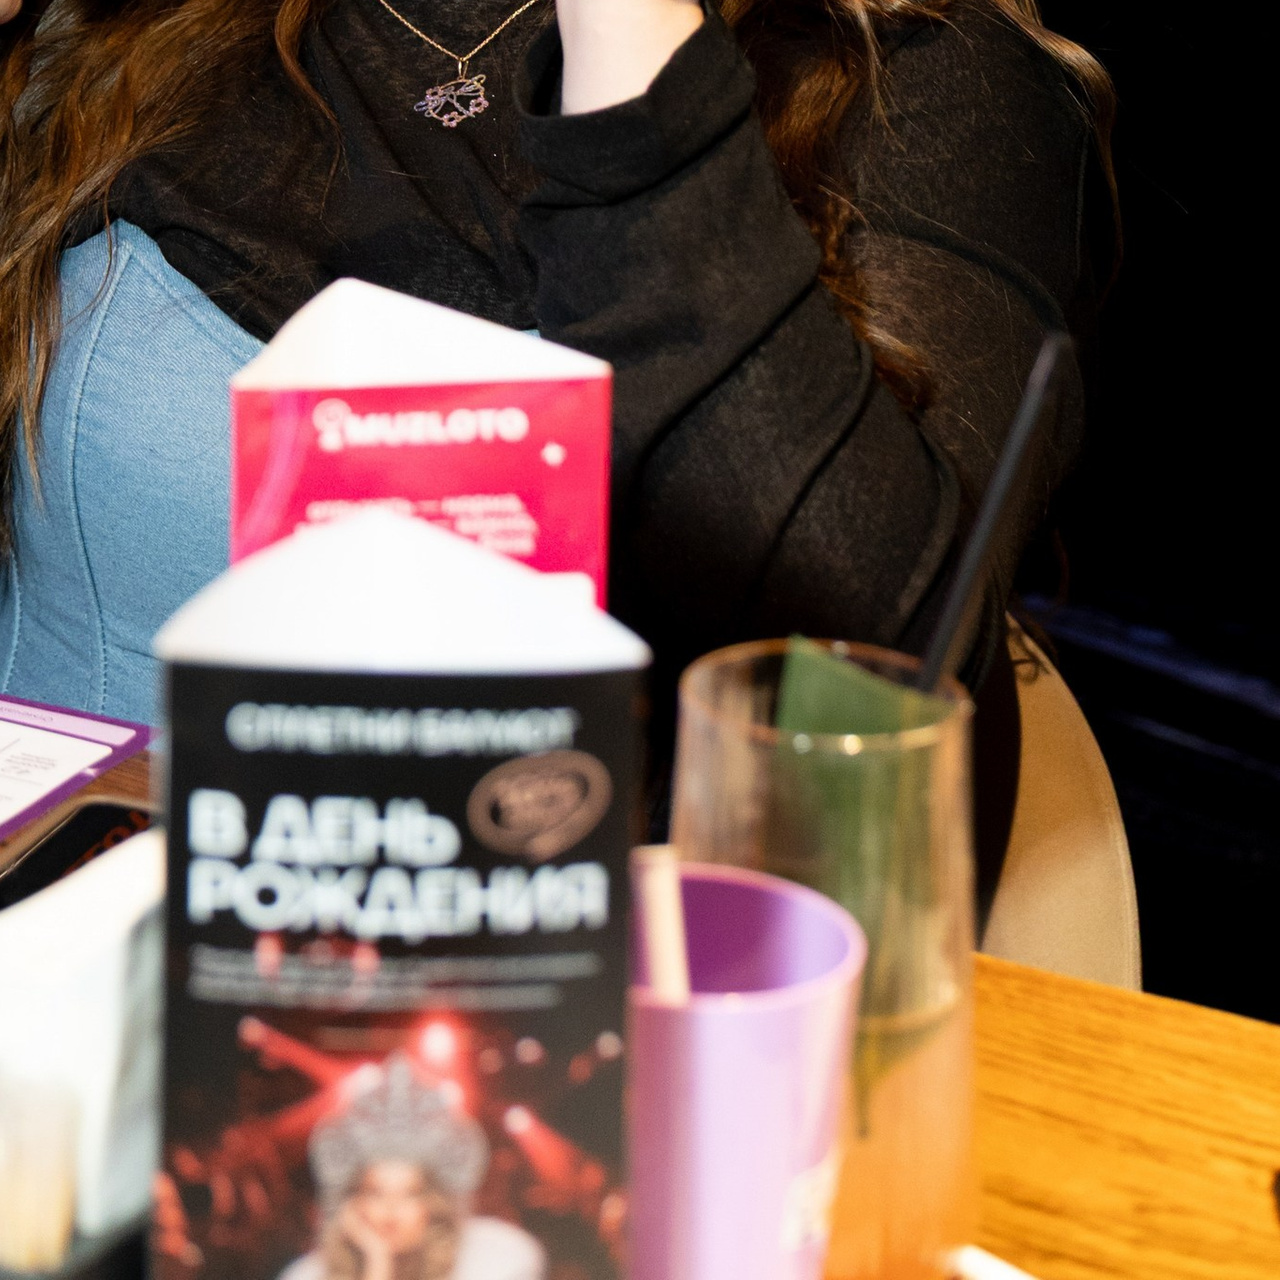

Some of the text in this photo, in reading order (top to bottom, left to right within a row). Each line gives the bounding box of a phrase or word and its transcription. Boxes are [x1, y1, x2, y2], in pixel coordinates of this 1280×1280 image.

[344, 406, 529, 446] MUZLOTO
[187, 787, 248, 858] В
[252, 793, 462, 868] ДЕНЬ
[186, 856, 610, 943] РОЖДЕНИЯ
